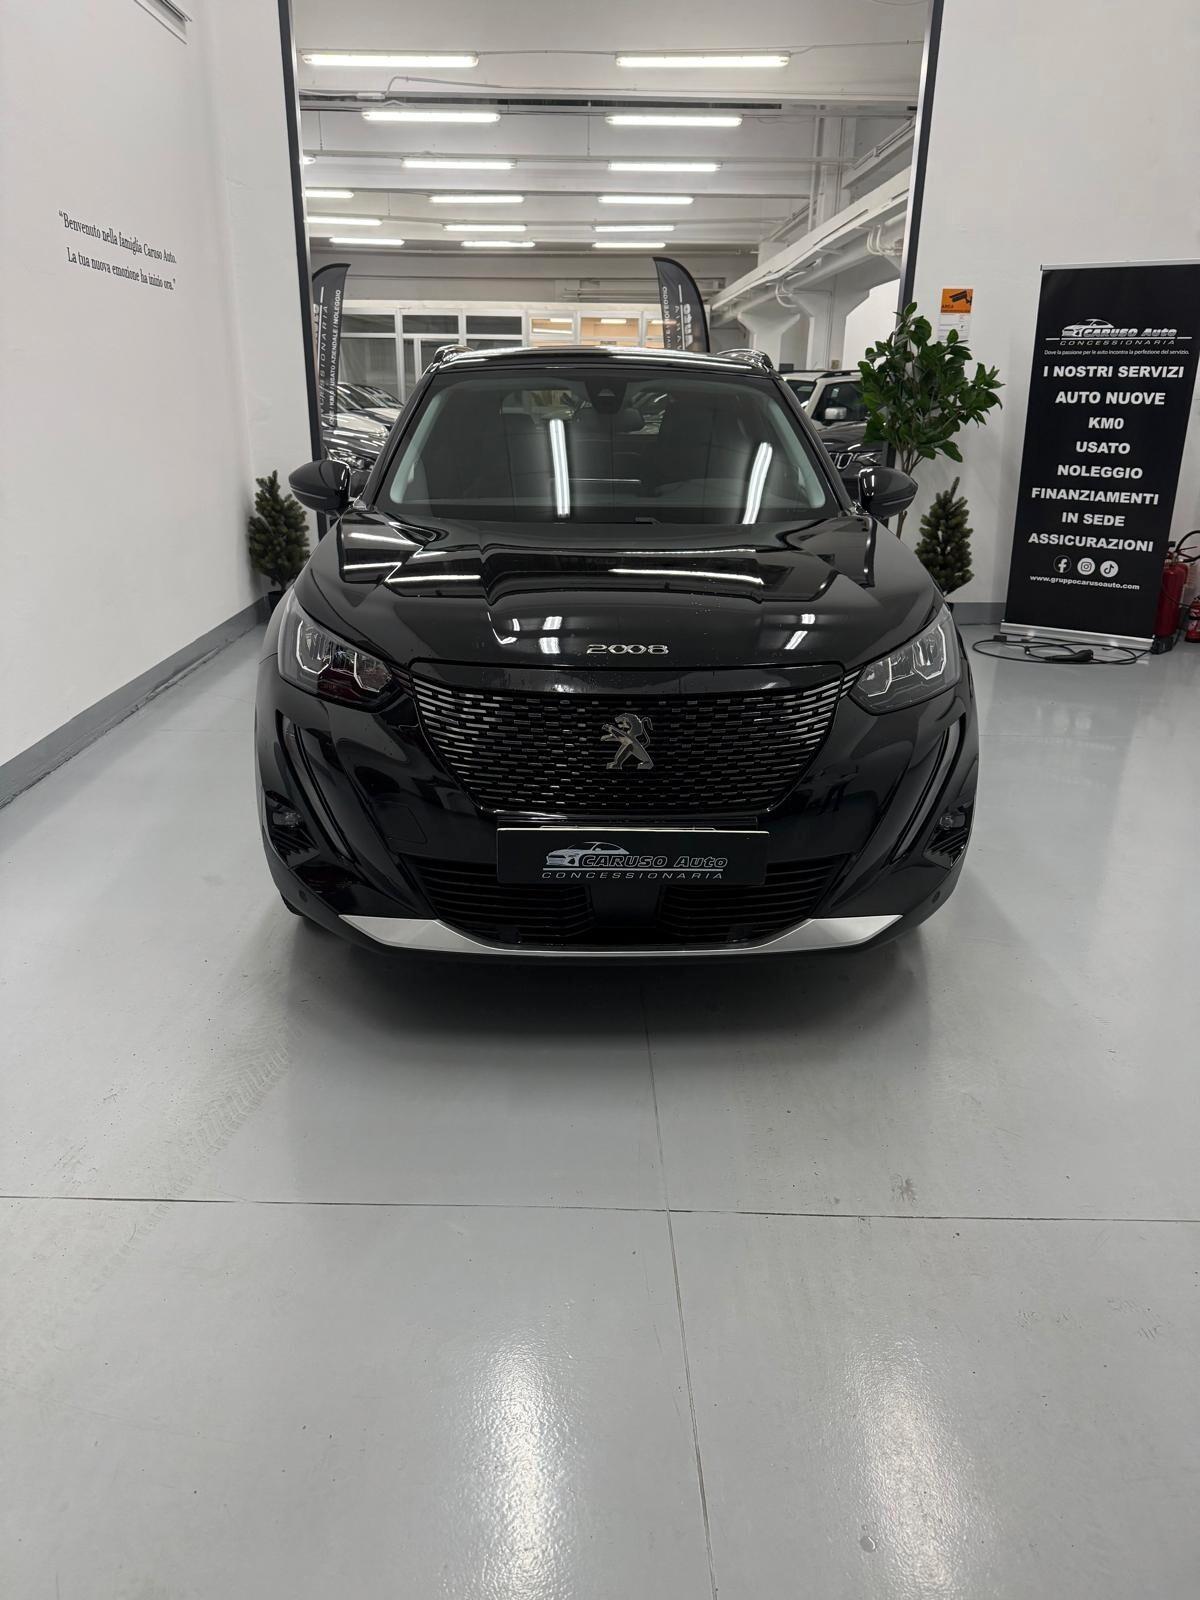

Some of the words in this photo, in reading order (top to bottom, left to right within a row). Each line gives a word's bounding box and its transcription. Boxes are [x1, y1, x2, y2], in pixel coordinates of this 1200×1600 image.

[102, 228, 118, 245] nella
[119, 232, 142, 255] famiglia
[144, 244, 163, 260] Caruso
[164, 249, 176, 263] Auto.
[67, 247, 77, 263] La
[79, 251, 90, 267] tua
[91, 258, 111, 273] nuova
[112, 266, 140, 281] emozione
[140, 269, 148, 283] ha
[148, 273, 163, 287] inizio
[333, 289, 341, 324] NOLEGGIO
[1083, 328, 1138, 338] CARUSO
[1141, 328, 1177, 337] Auto
[1043, 366, 1049, 377] I
[1053, 366, 1113, 377] NOSTRI
[1118, 366, 1184, 378] SERVIZI
[1055, 391, 1101, 404] AUTO
[1105, 392, 1166, 405] NUOVE
[1088, 417, 1124, 429] KM0
[1075, 441, 1131, 454] USATO
[1057, 464, 1143, 479] NOLEGGIO
[1031, 487, 1159, 505] FINANZIAMENTI
[1061, 512, 1079, 523] IN
[1083, 513, 1126, 527] SEDE
[1028, 533, 1154, 552] ASSICURAZIONI
[1030, 575, 1140, 590] www.gruppocarusoauto.com
[586, 644, 669, 655] 2008
[581, 855, 668, 868] CARUSO
[673, 856, 728, 868] Auto
